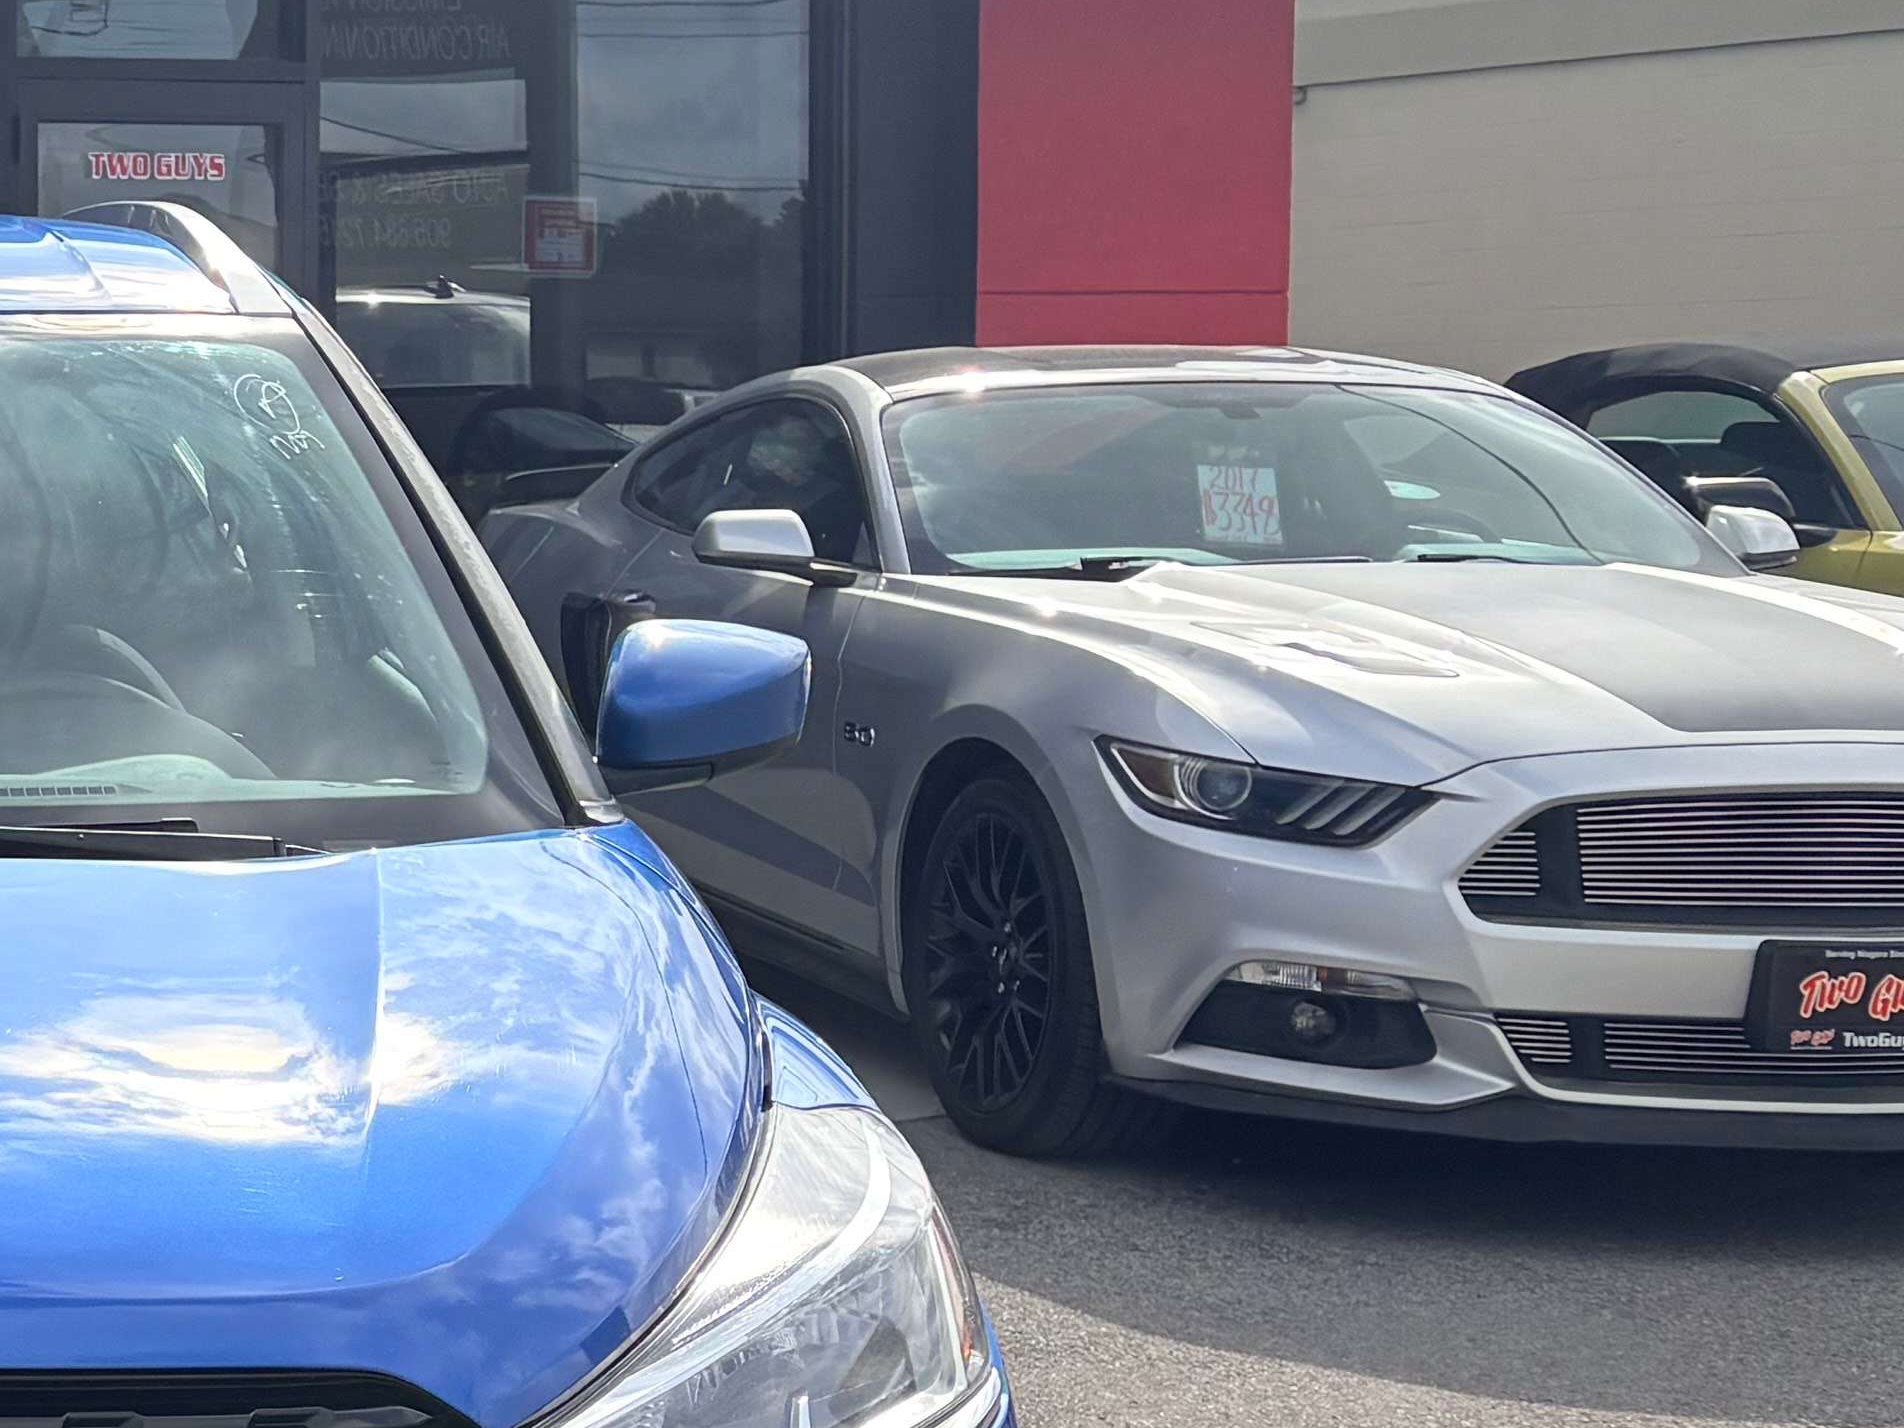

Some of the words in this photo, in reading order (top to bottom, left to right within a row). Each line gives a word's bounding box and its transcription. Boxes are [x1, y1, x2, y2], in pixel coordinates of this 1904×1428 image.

[88, 152, 150, 180] TWO
[154, 152, 225, 180] GUYS
[1800, 971, 1867, 1018] Two
